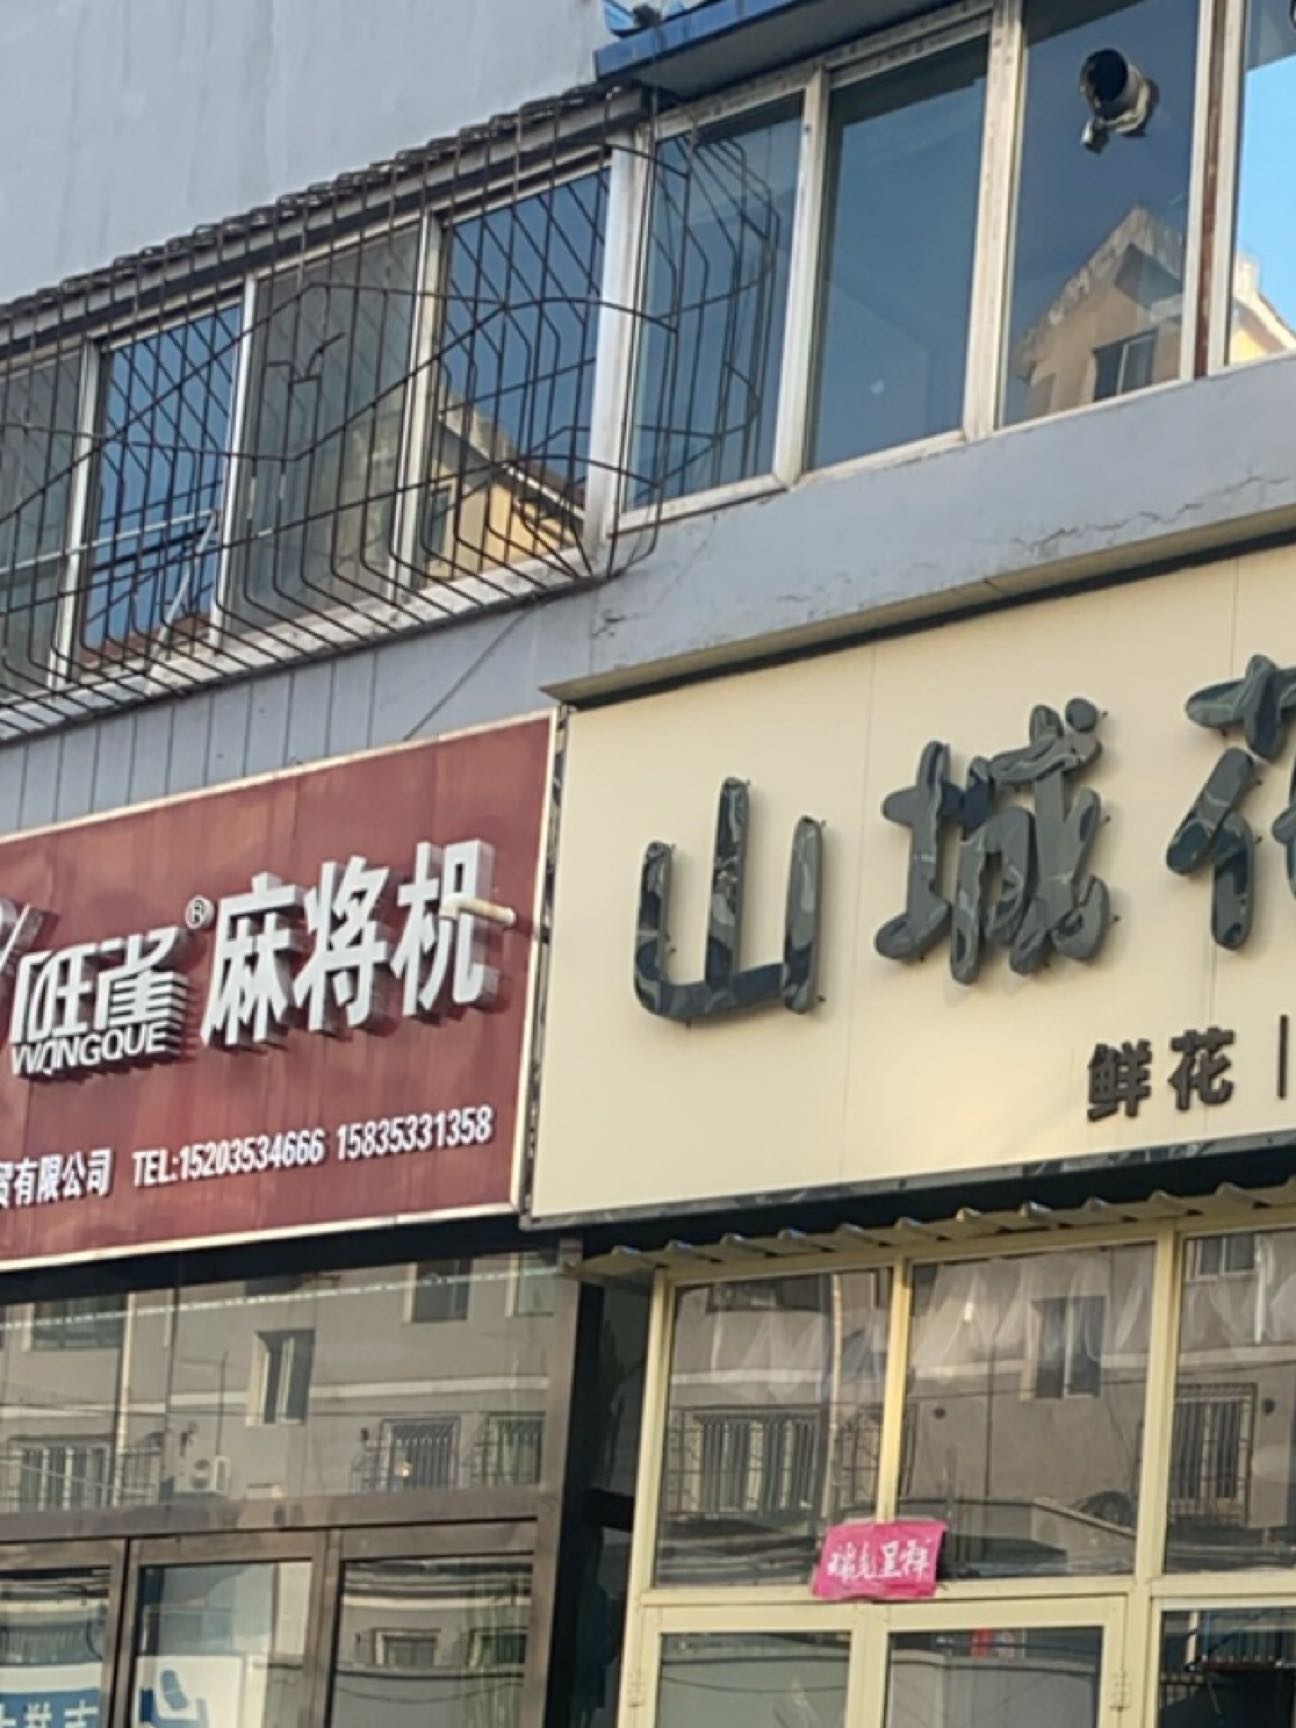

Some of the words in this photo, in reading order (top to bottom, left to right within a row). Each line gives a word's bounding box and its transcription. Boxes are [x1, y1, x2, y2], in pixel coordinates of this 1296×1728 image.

[200, 838, 492, 1046] 麻将机
[12, 1020, 172, 1076] WONGQUE
[1088, 1028, 1235, 1122] 鲜花
[132, 1128, 325, 1188] TEL:15203534666
[336, 1105, 493, 1160] 15835331358
